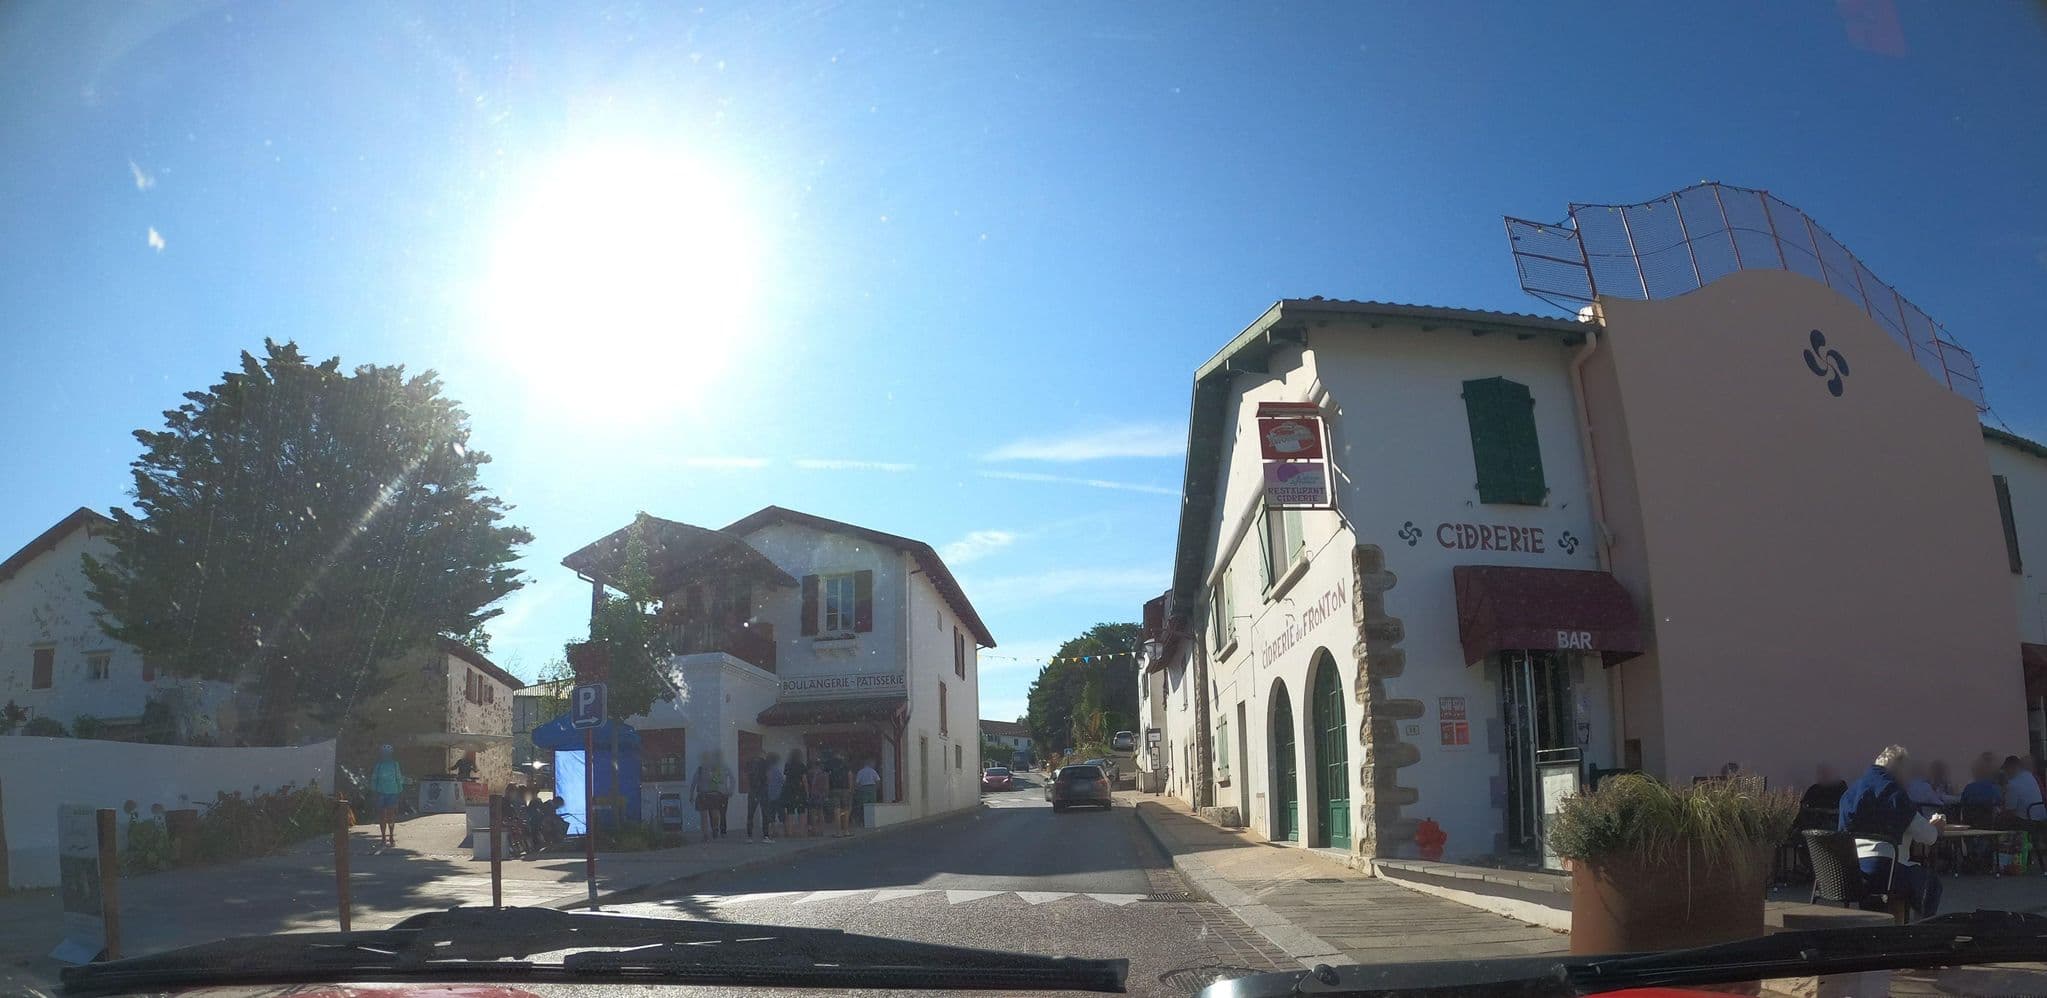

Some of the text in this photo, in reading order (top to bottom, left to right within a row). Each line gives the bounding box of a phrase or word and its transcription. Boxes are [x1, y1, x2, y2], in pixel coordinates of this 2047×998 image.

[1557, 631, 1592, 649] BAR
[783, 678, 850, 690] BOULANGERIE
[579, 687, 596, 716] P
